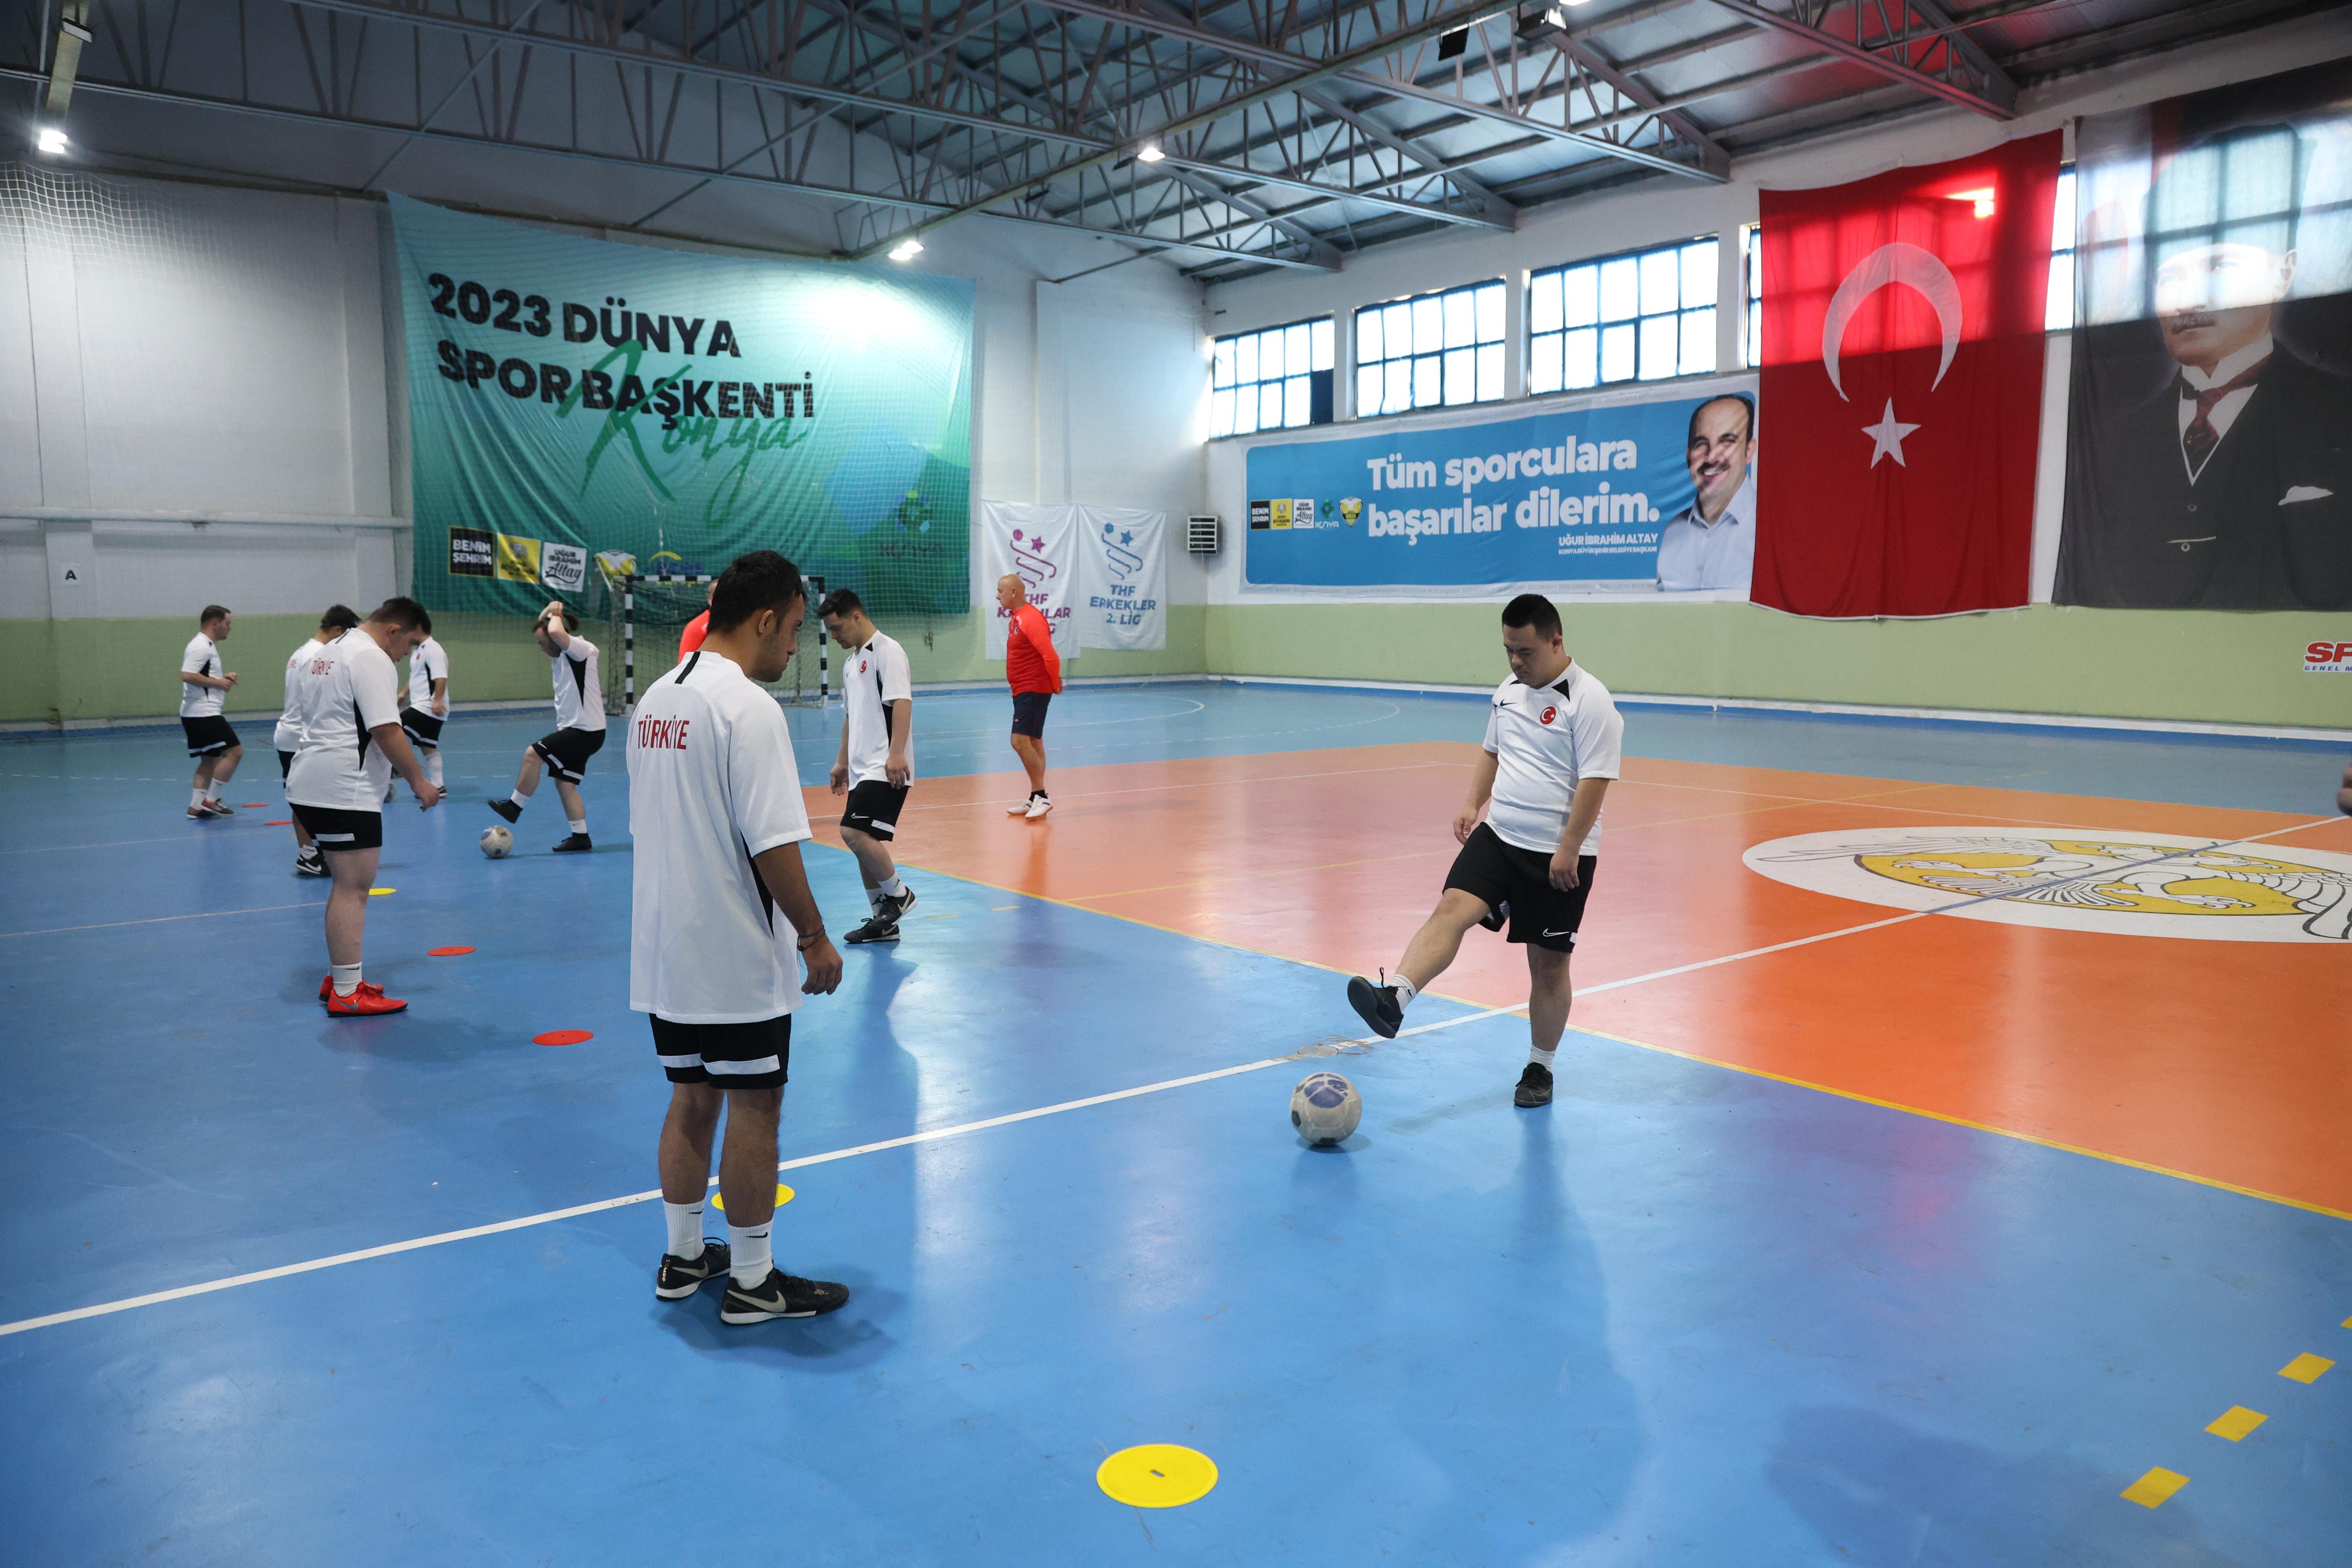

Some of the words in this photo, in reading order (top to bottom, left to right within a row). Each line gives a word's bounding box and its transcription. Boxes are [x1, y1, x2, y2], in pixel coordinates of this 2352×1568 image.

[428, 273, 552, 337] 2023
[563, 296, 741, 357] DÜNYA
[438, 340, 571, 404] SPOR
[582, 371, 814, 430] BAŞKENTİ
[555, 339, 808, 529] Konya
[1367, 453, 1437, 491] Tüm
[1445, 435, 1637, 493] sporculara
[1368, 498, 1508, 545] başarılar
[1516, 481, 1660, 528] dilerim.
[1559, 533, 1584, 546] UĞUR
[1585, 532, 1625, 545] İBRAHİM
[1626, 533, 1658, 544] ALTAY
[65, 570, 77, 580] A
[1111, 584, 1136, 596] THF
[997, 607, 1071, 618] KLAR
[1090, 596, 1156, 611] ERKEKLER
[1106, 612, 1116, 624] 2.
[1120, 611, 1142, 625] LİG
[638, 714, 690, 750] TÜRKİYE
